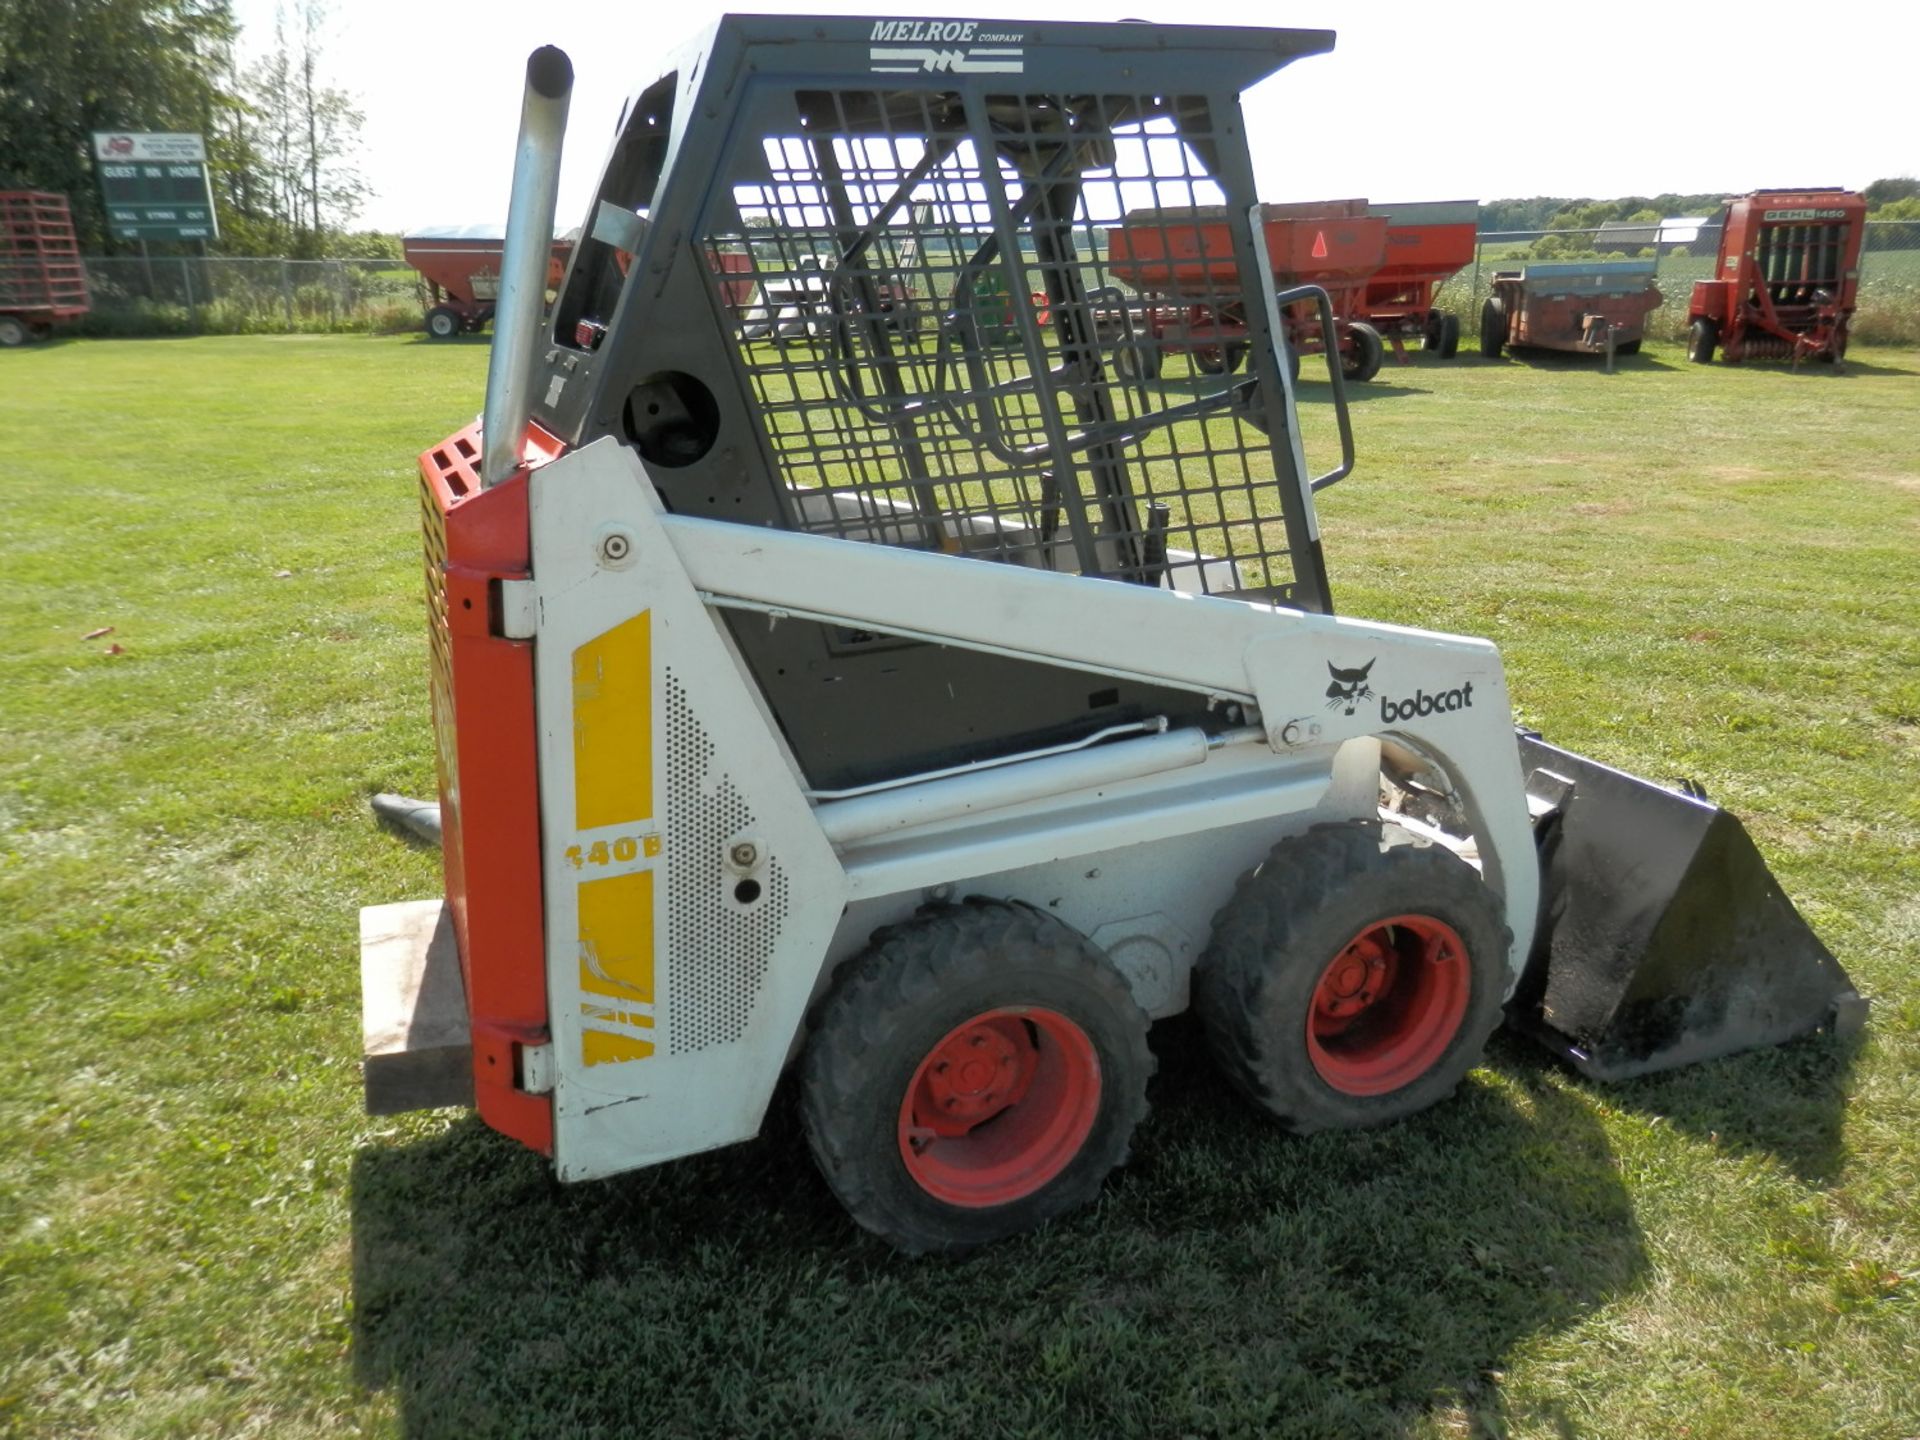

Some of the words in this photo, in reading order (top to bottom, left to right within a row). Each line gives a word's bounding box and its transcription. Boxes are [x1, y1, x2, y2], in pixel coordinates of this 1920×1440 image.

[870, 21, 978, 42] MELROE
[978, 34, 1024, 43] COMPANY
[1765, 210, 1815, 220] GEHL
[1380, 681, 1474, 724] bobcat
